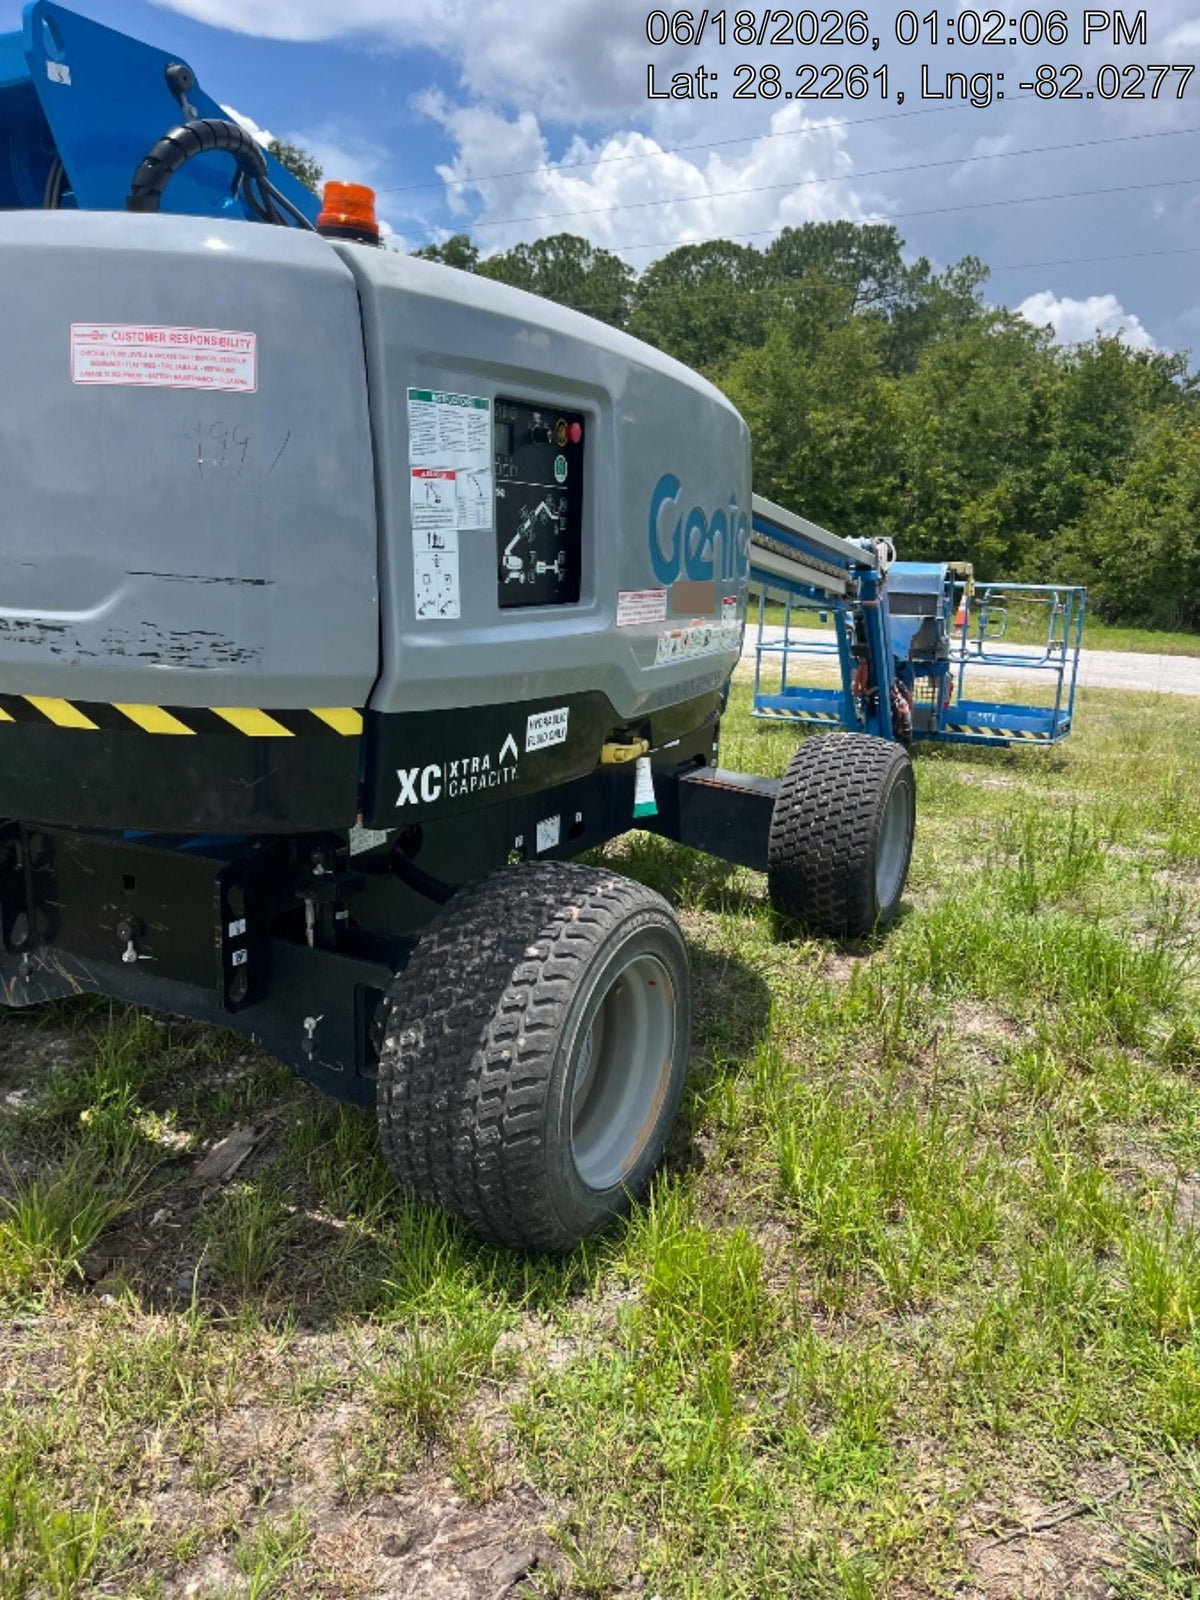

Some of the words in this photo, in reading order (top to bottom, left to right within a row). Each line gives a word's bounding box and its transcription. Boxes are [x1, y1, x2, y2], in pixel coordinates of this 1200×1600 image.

[111, 330, 166, 343] CUSTOMER
[169, 333, 252, 349] RESPONSIBILITY
[649, 473, 748, 586] Genie
[396, 764, 441, 806] XC
[449, 754, 491, 778] XTRA
[449, 765, 517, 797] CAPACITY
